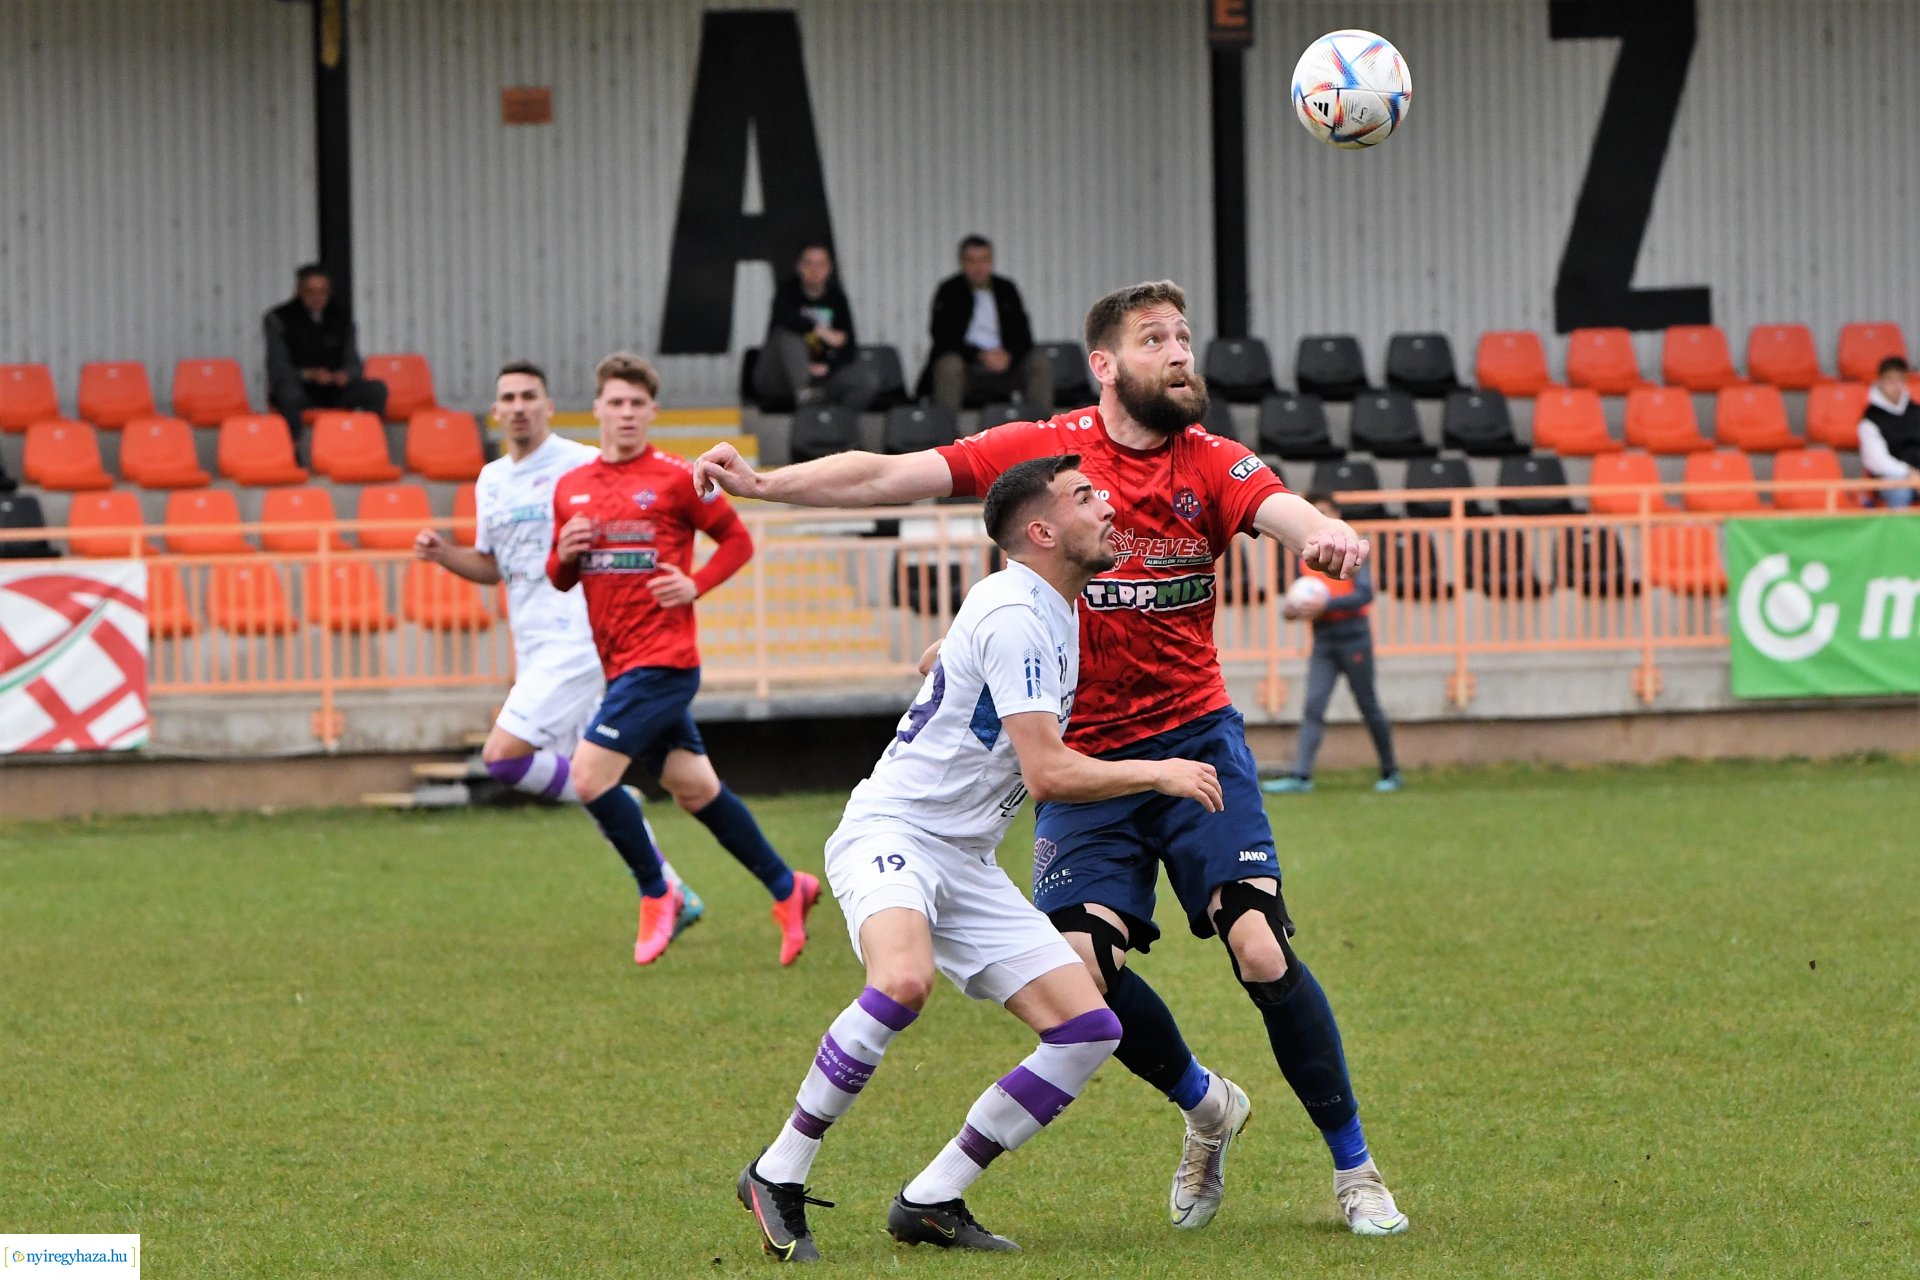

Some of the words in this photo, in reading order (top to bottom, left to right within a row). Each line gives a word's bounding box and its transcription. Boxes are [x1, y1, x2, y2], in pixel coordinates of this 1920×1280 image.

[1550, 0, 1711, 334] Z
[660, 10, 850, 355] A
[1086, 578, 1212, 606] TiPPMIX
[871, 854, 906, 873] 19
[1239, 851, 1268, 862] JAKO
